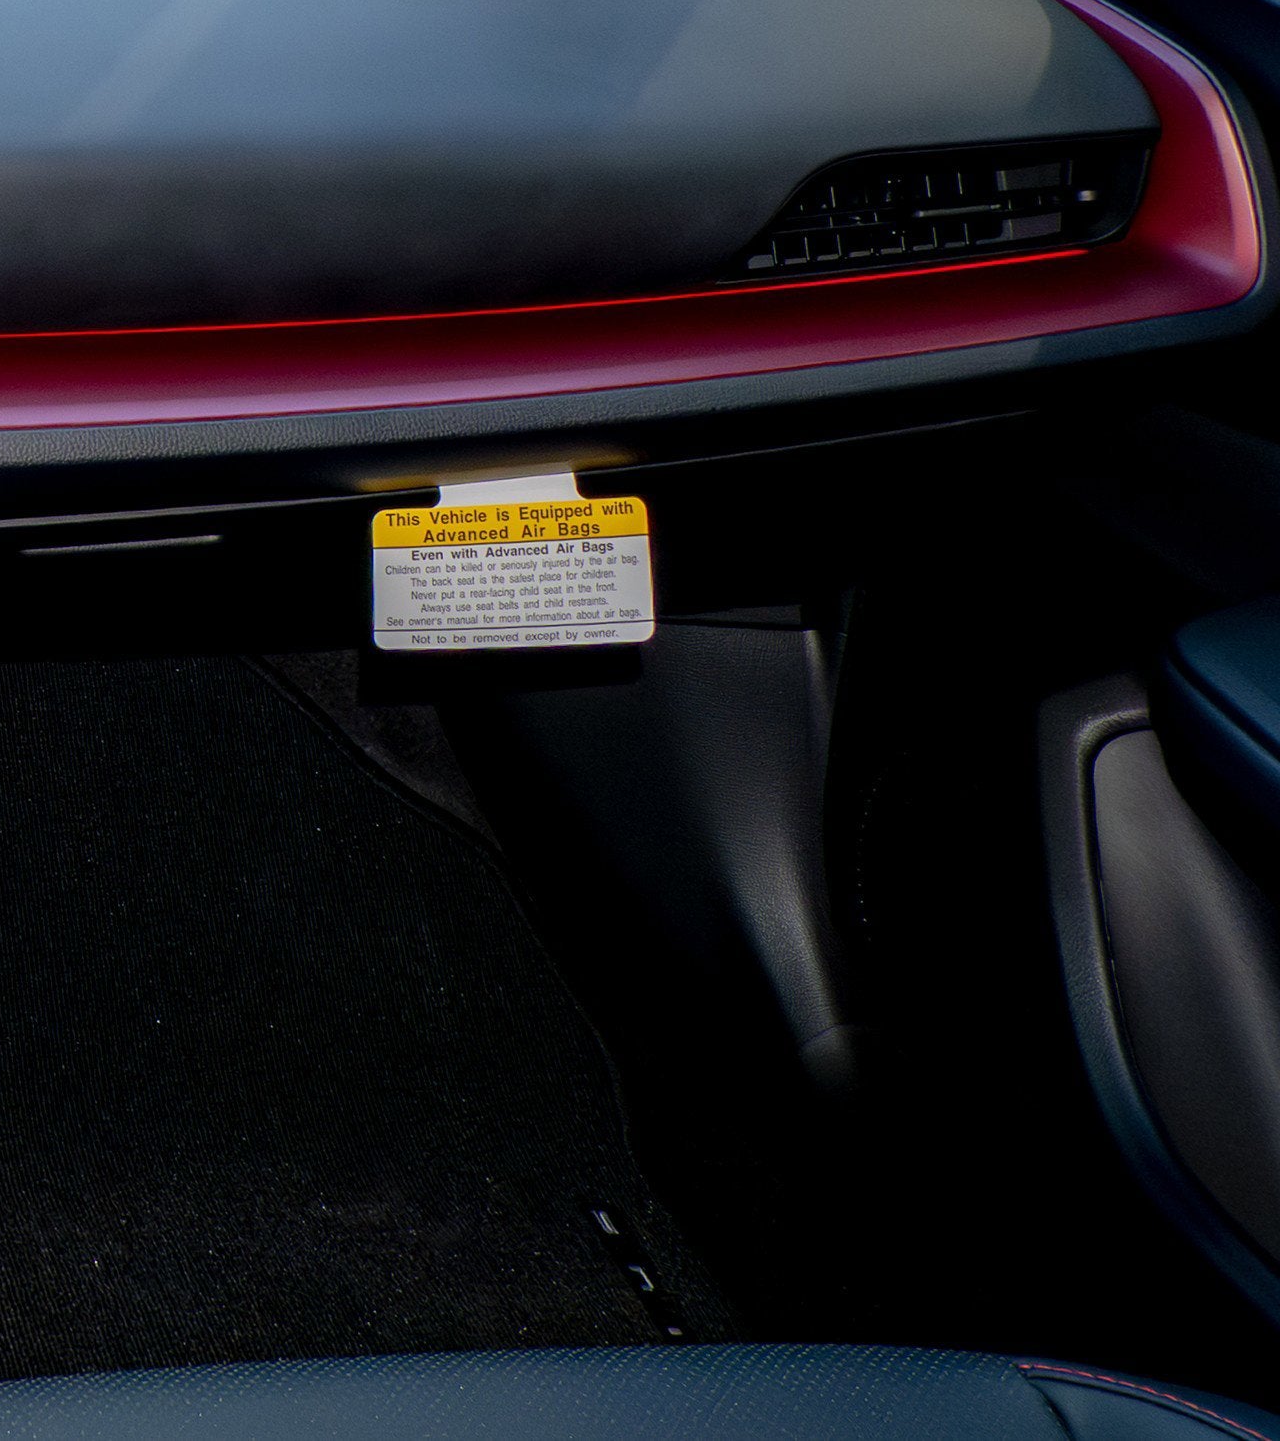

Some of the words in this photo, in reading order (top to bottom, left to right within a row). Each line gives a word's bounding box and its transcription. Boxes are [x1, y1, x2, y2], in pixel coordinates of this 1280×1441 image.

[386, 513, 421, 526] This
[430, 509, 487, 525] Vehicle
[496, 507, 510, 521] is
[519, 503, 593, 523] Equipped
[602, 501, 634, 516] with
[423, 526, 509, 543] Advanced
[521, 524, 546, 538] Air
[558, 522, 601, 537] Bags
[411, 550, 444, 561] Even
[451, 548, 478, 559] with
[485, 544, 549, 558] Advanced
[556, 543, 575, 554] Air
[582, 541, 614, 554] Bags
[411, 635, 431, 645] Not
[436, 634, 447, 644] to
[453, 633, 467, 643] be
[472, 632, 519, 643] removed
[525, 631, 561, 643] except
[565, 629, 578, 641] by
[583, 628, 620, 639] owner.
